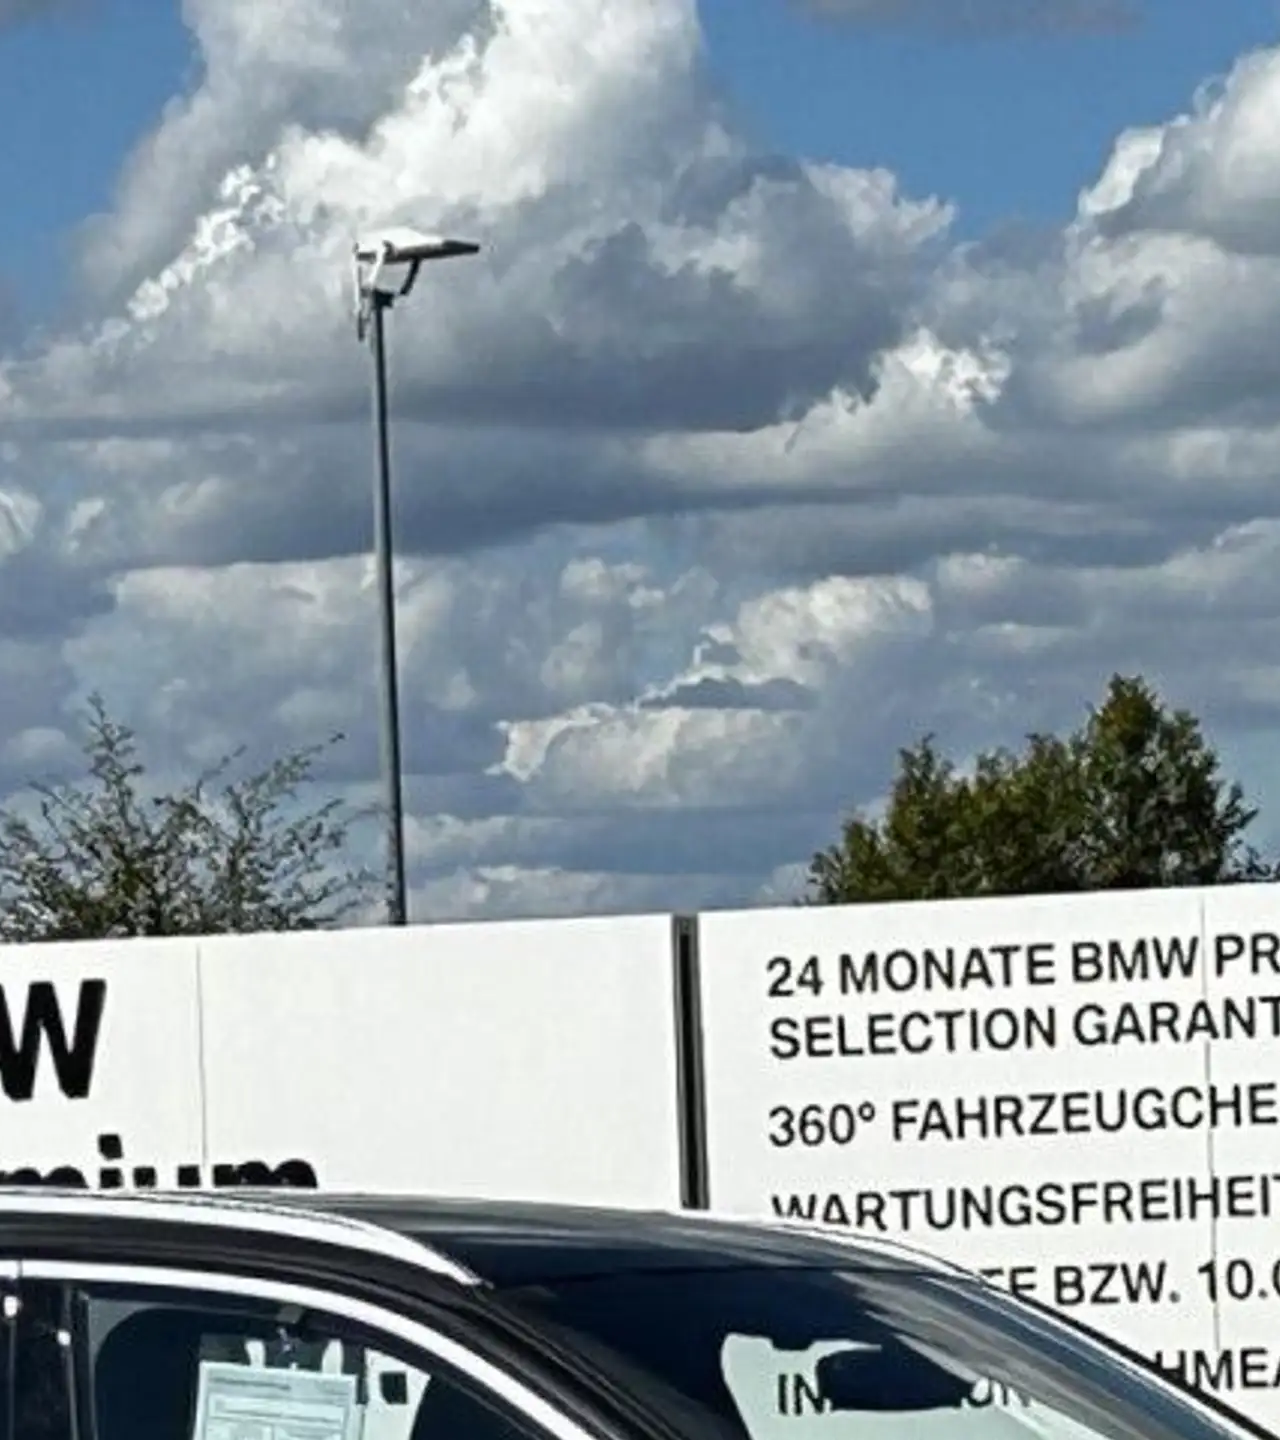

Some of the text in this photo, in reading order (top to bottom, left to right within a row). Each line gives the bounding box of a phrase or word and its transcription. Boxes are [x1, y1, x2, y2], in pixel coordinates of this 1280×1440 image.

[767, 956, 823, 997] 24
[840, 943, 1055, 994] MONATE
[1072, 936, 1199, 982] BMW
[769, 1004, 1056, 1059] SELECTION
[768, 1099, 876, 1147] 360°
[1053, 1261, 1182, 1306] BZW.
